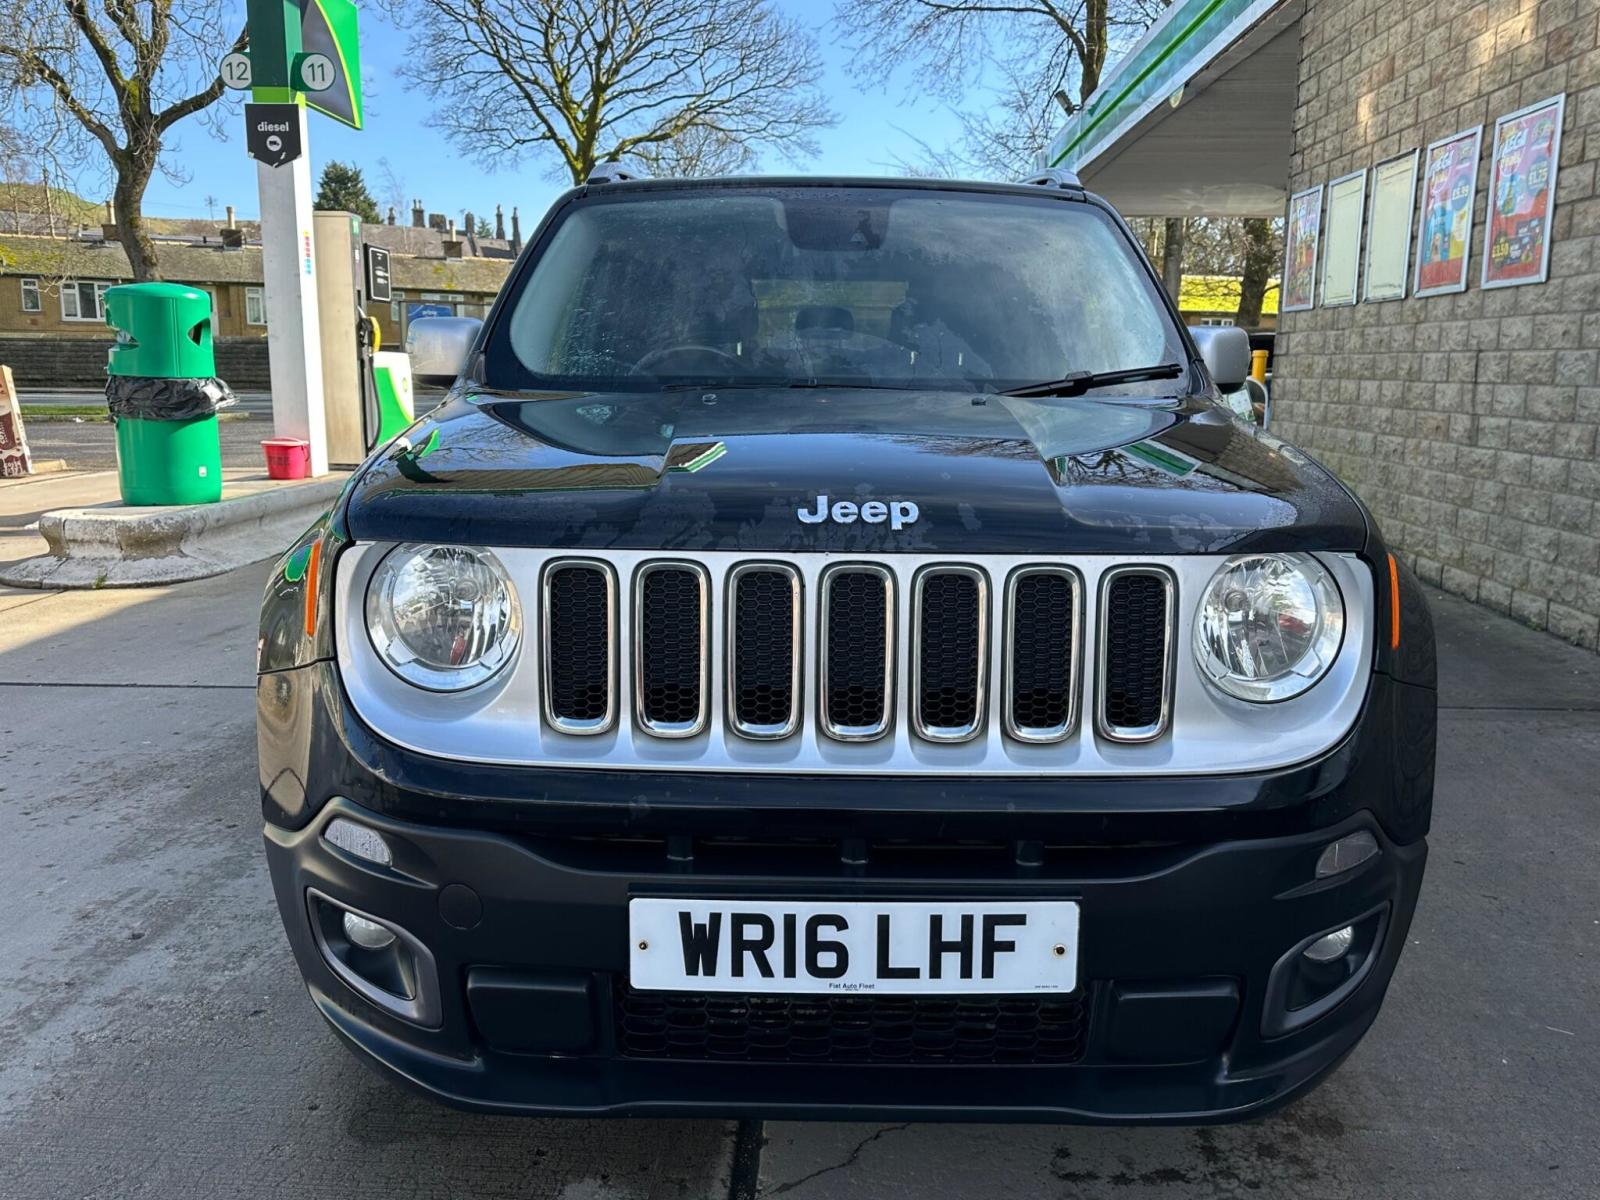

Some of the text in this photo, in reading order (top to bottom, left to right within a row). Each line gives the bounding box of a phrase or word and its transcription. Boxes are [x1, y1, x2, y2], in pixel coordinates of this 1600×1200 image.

[225, 61, 249, 81] 12
[307, 62, 326, 82] 11
[257, 121, 290, 132] diesel
[797, 495, 919, 530] Jeep
[678, 911, 1028, 980] WR16 LHF
